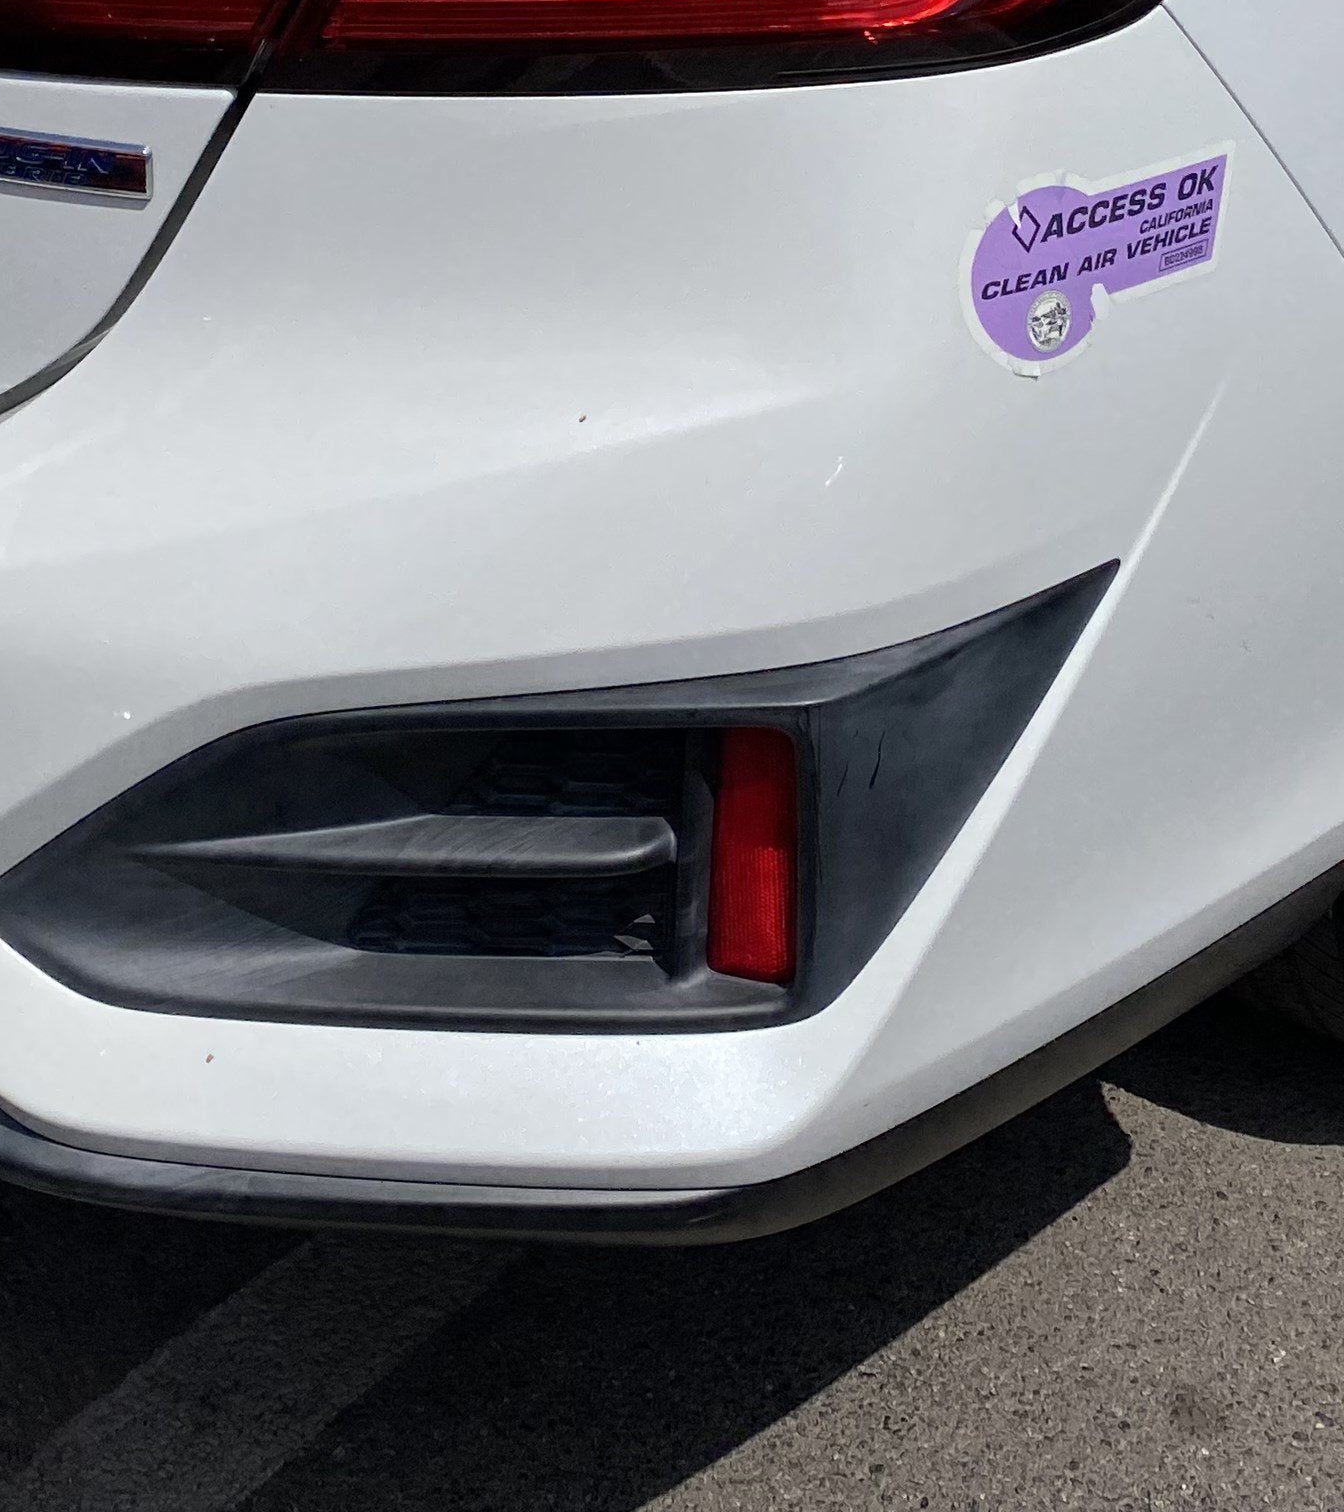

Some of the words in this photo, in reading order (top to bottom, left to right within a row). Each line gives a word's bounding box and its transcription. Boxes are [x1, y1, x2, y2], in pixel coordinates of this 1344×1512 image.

[1040, 182, 1167, 243] ACCESS
[1177, 165, 1219, 201] OK
[1139, 198, 1214, 234] CALIFORNIA
[981, 262, 1070, 301] CLEAN
[1076, 248, 1118, 276] AIR
[1126, 216, 1213, 260] VEHICLE
